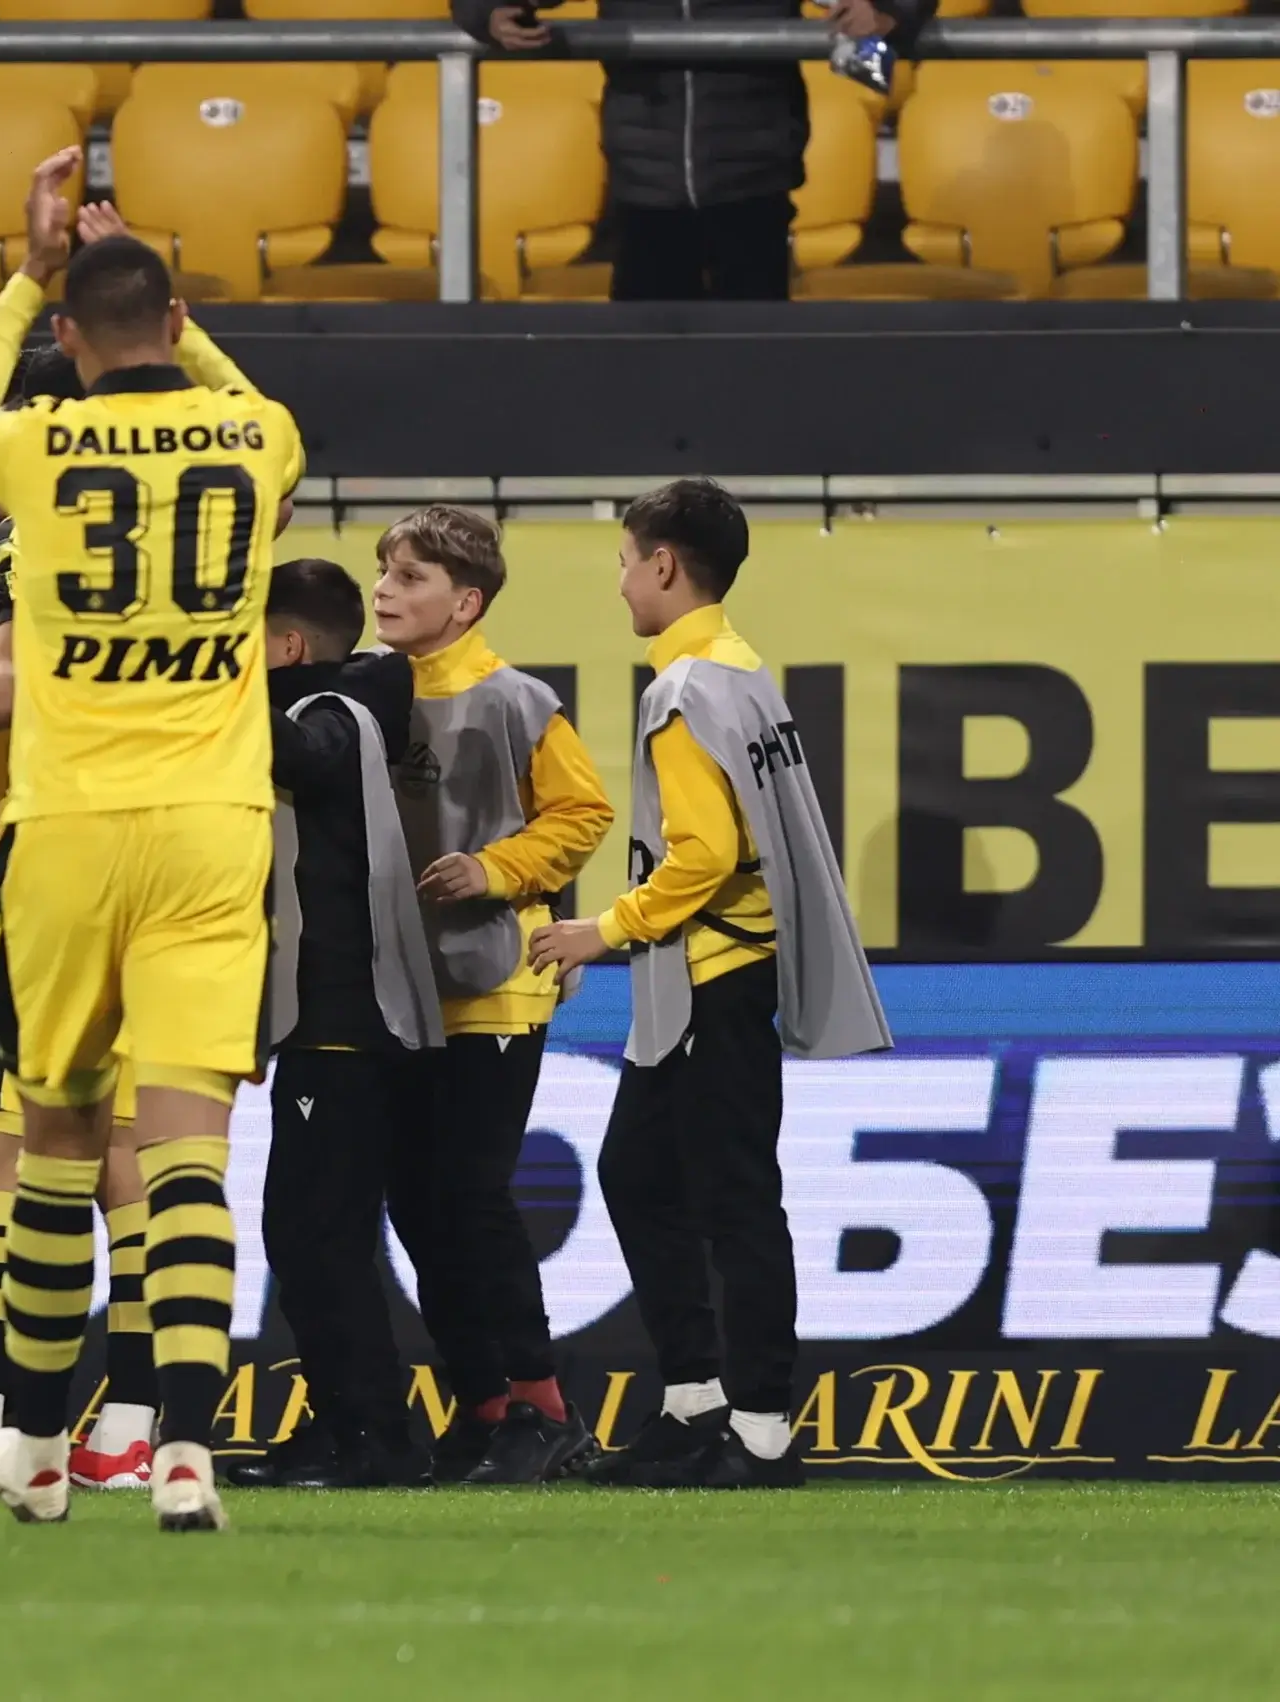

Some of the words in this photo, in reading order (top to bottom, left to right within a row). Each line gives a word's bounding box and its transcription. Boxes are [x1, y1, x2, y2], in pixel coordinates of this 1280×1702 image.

[46, 420, 264, 457] DALLBOGG
[53, 464, 262, 622] 30
[52, 633, 250, 683] PIMK
